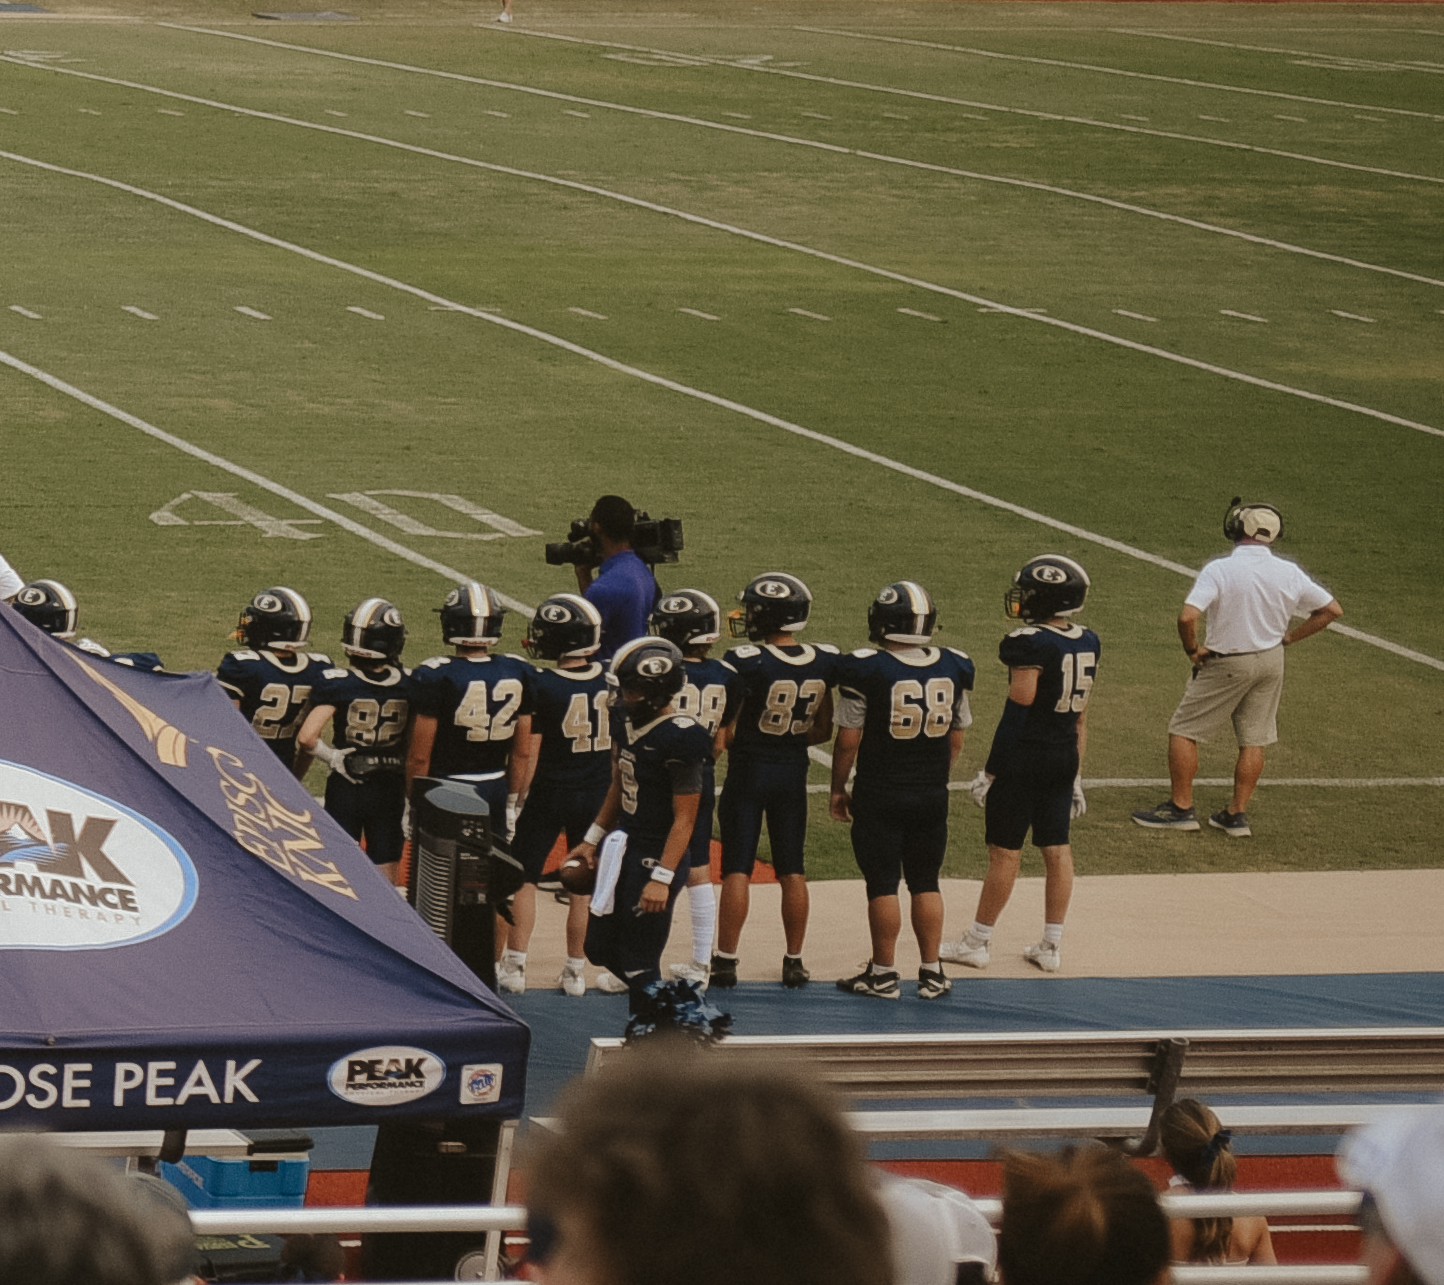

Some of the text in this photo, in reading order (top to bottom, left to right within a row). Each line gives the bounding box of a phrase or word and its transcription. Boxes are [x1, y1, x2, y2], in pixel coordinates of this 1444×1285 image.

[252, 682, 313, 740] 27
[453, 678, 523, 742] 42
[758, 678, 827, 736] 83
[888, 676, 955, 740] 68
[1054, 651, 1096, 714] 15
[345, 698, 409, 748] 82
[562, 689, 612, 753] 41
[206, 746, 296, 876] EPISC
[28, 900, 142, 927] THERAPY
[113, 1058, 263, 1107] PEAK
[347, 1058, 429, 1082] PEAK
